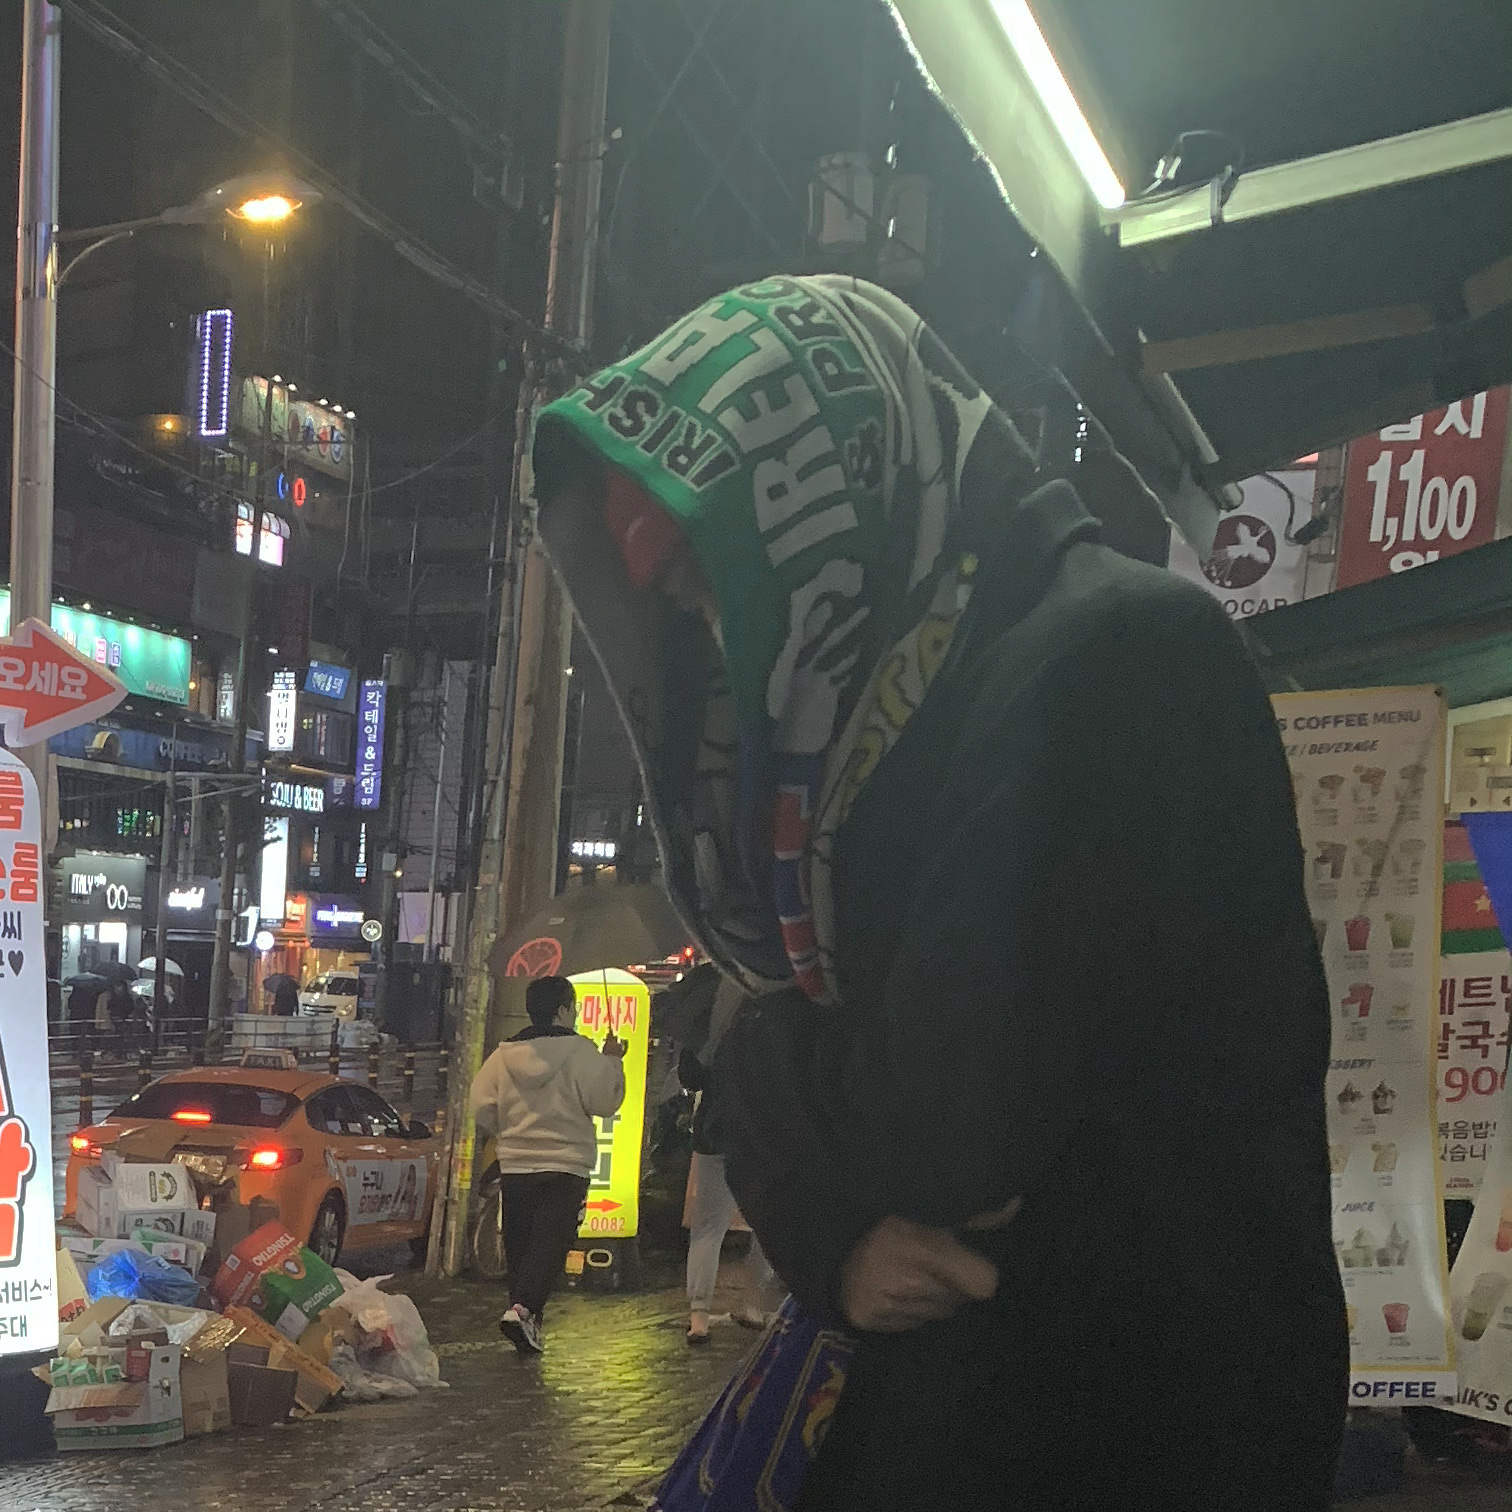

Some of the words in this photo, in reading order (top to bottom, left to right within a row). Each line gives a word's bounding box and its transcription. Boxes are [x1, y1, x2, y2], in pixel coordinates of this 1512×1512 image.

[1367, 449, 1477, 551] 1,100
[1294, 713, 1368, 730] COFFEE
[303, 786, 324, 813] BEER
[71, 873, 93, 895] ITALY
[582, 995, 638, 1033] 마사지
[252, 1232, 295, 1267] TSINGTAO
[302, 1282, 337, 1313] TSINGTAO
[1352, 1381, 1437, 1399] OFFEE
